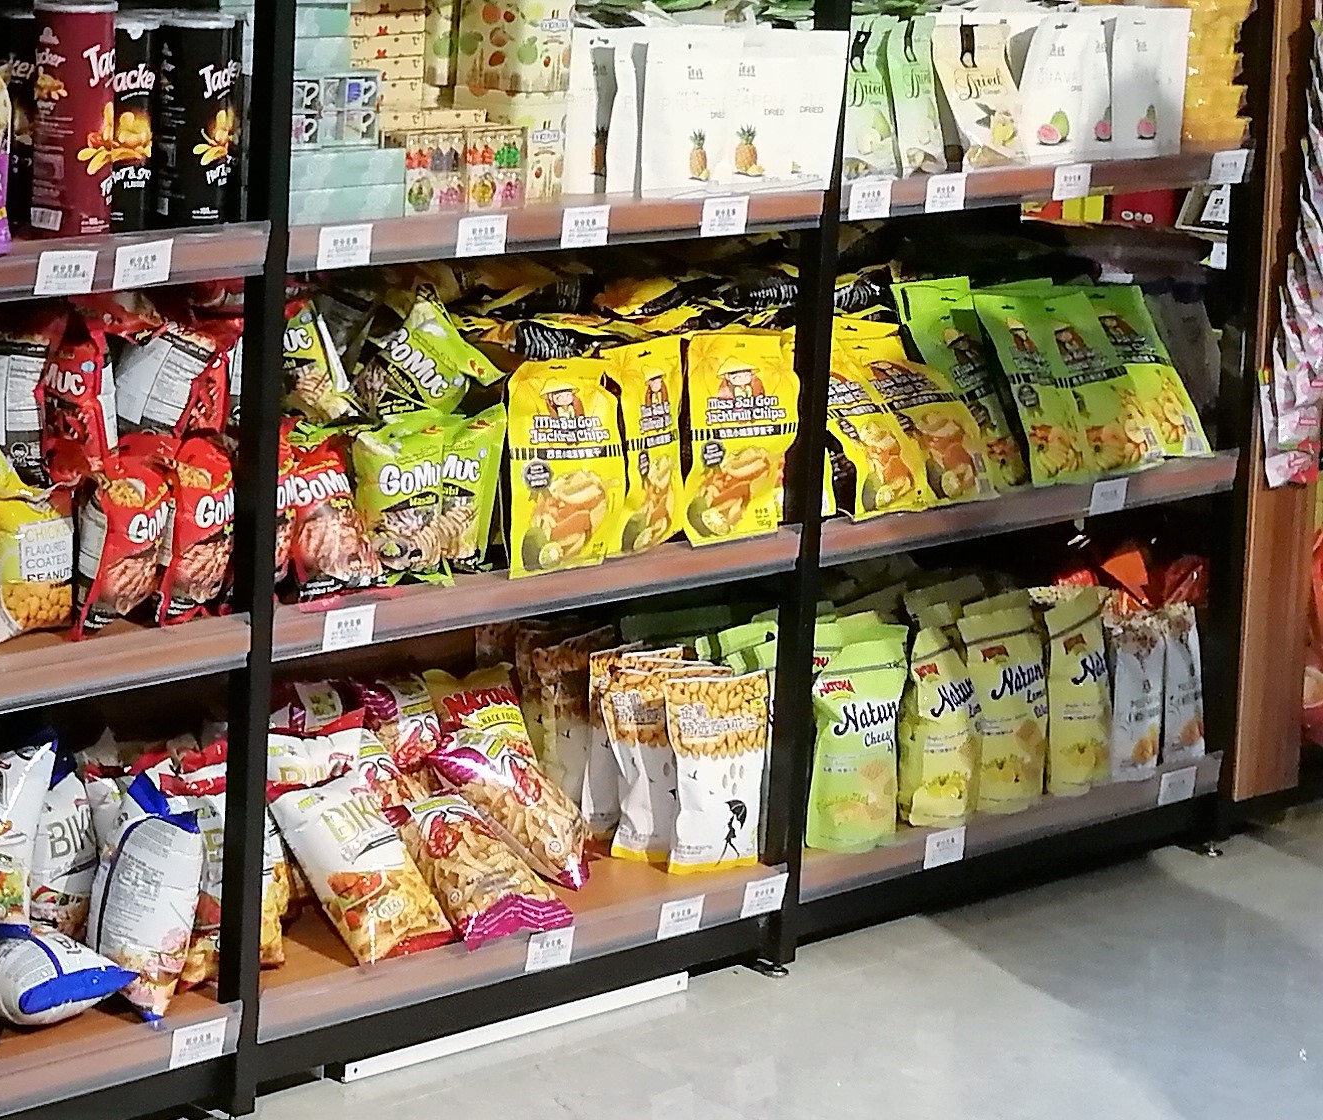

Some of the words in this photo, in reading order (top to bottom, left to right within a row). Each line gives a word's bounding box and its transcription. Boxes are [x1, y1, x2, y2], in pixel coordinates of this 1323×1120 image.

[954, 71, 1003, 101] Dried
[800, 106, 823, 115] DRIED
[755, 395, 779, 409] Gon
[577, 415, 601, 429] Gon
[705, 409, 753, 425] Jackfruit
[753, 407, 786, 422] Chips
[577, 428, 610, 443] Chips
[26, 540, 68, 557] FLAVOURED
[26, 555, 69, 569] COATED
